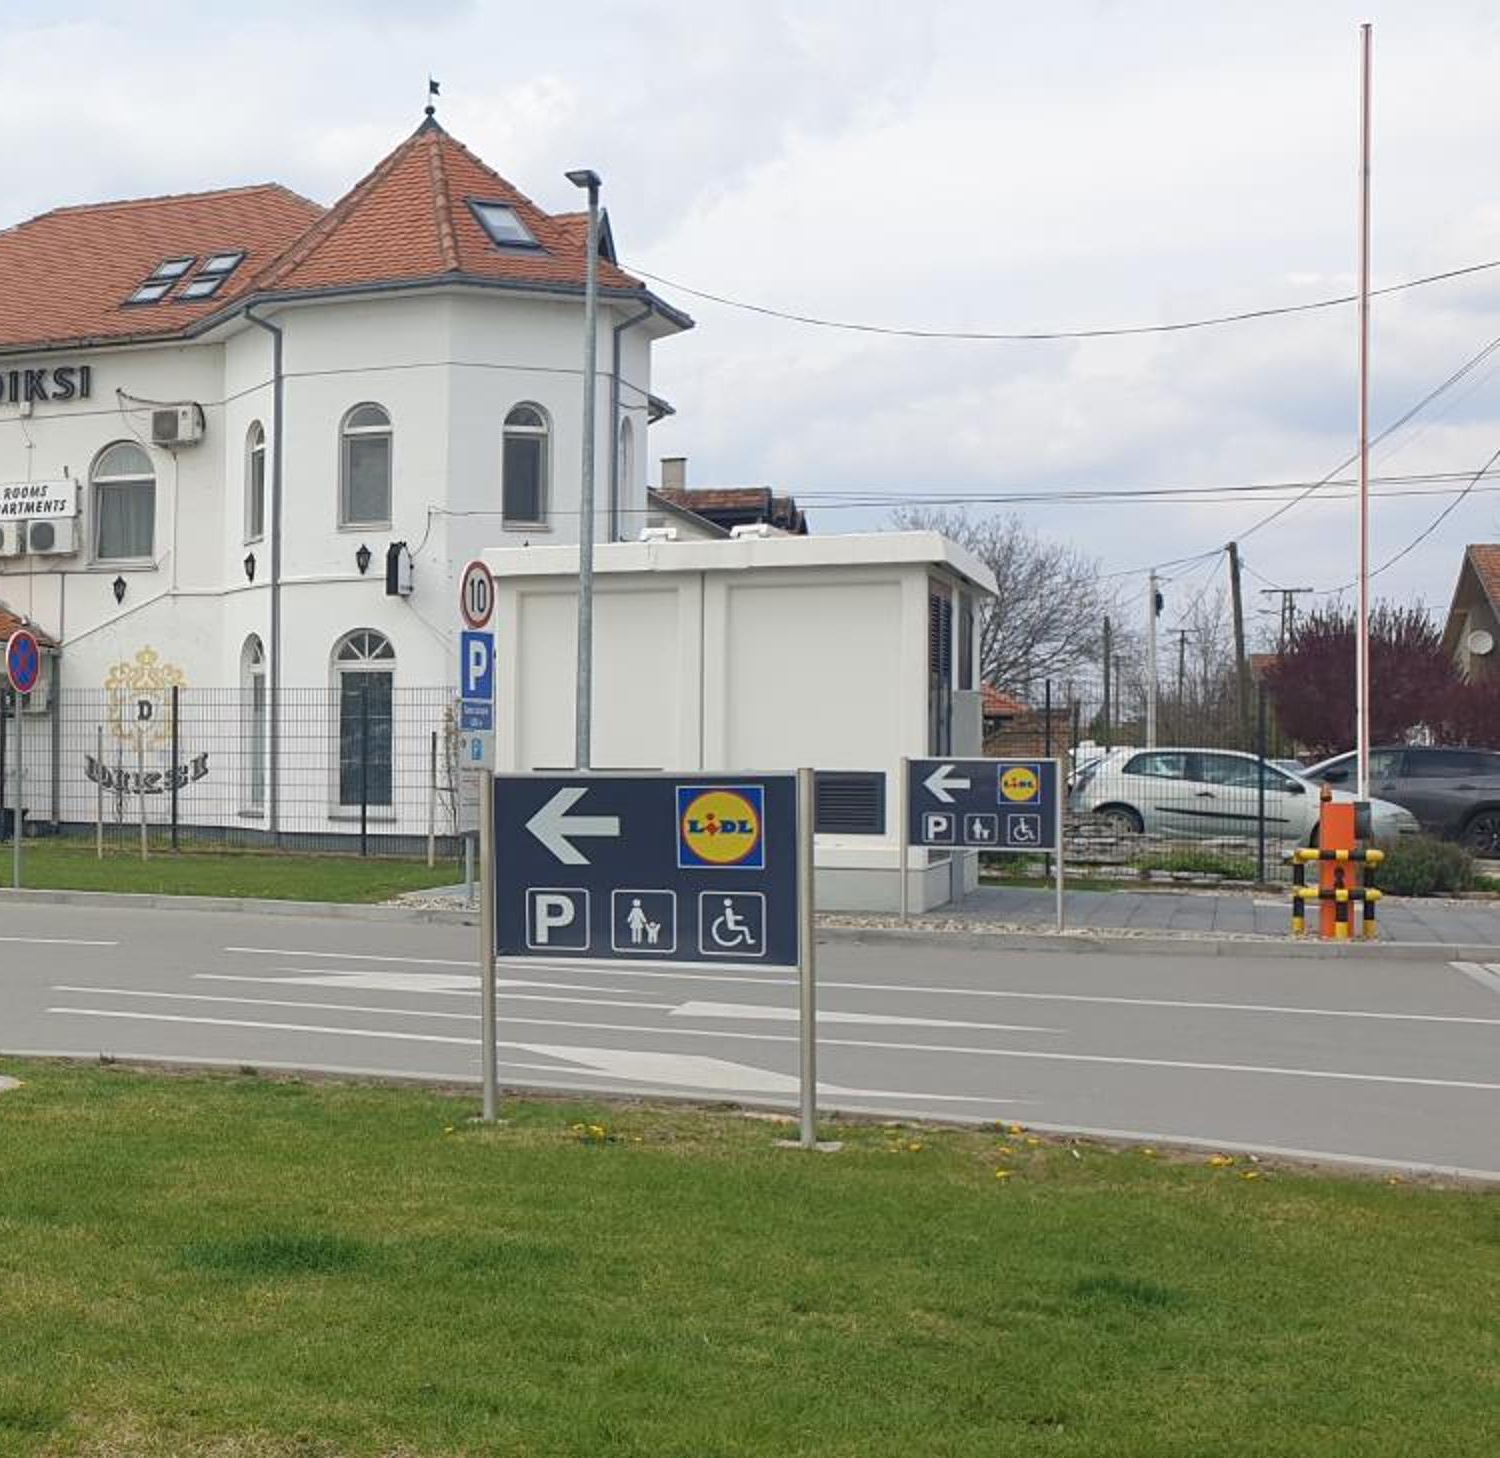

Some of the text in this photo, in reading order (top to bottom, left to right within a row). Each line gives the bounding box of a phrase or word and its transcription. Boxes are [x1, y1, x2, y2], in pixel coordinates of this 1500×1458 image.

[3, 486, 48, 499] ROOMS
[469, 579, 486, 613] 10
[469, 640, 487, 690] P
[138, 700, 152, 720] D
[928, 816, 948, 839] P
[536, 895, 575, 944] P
